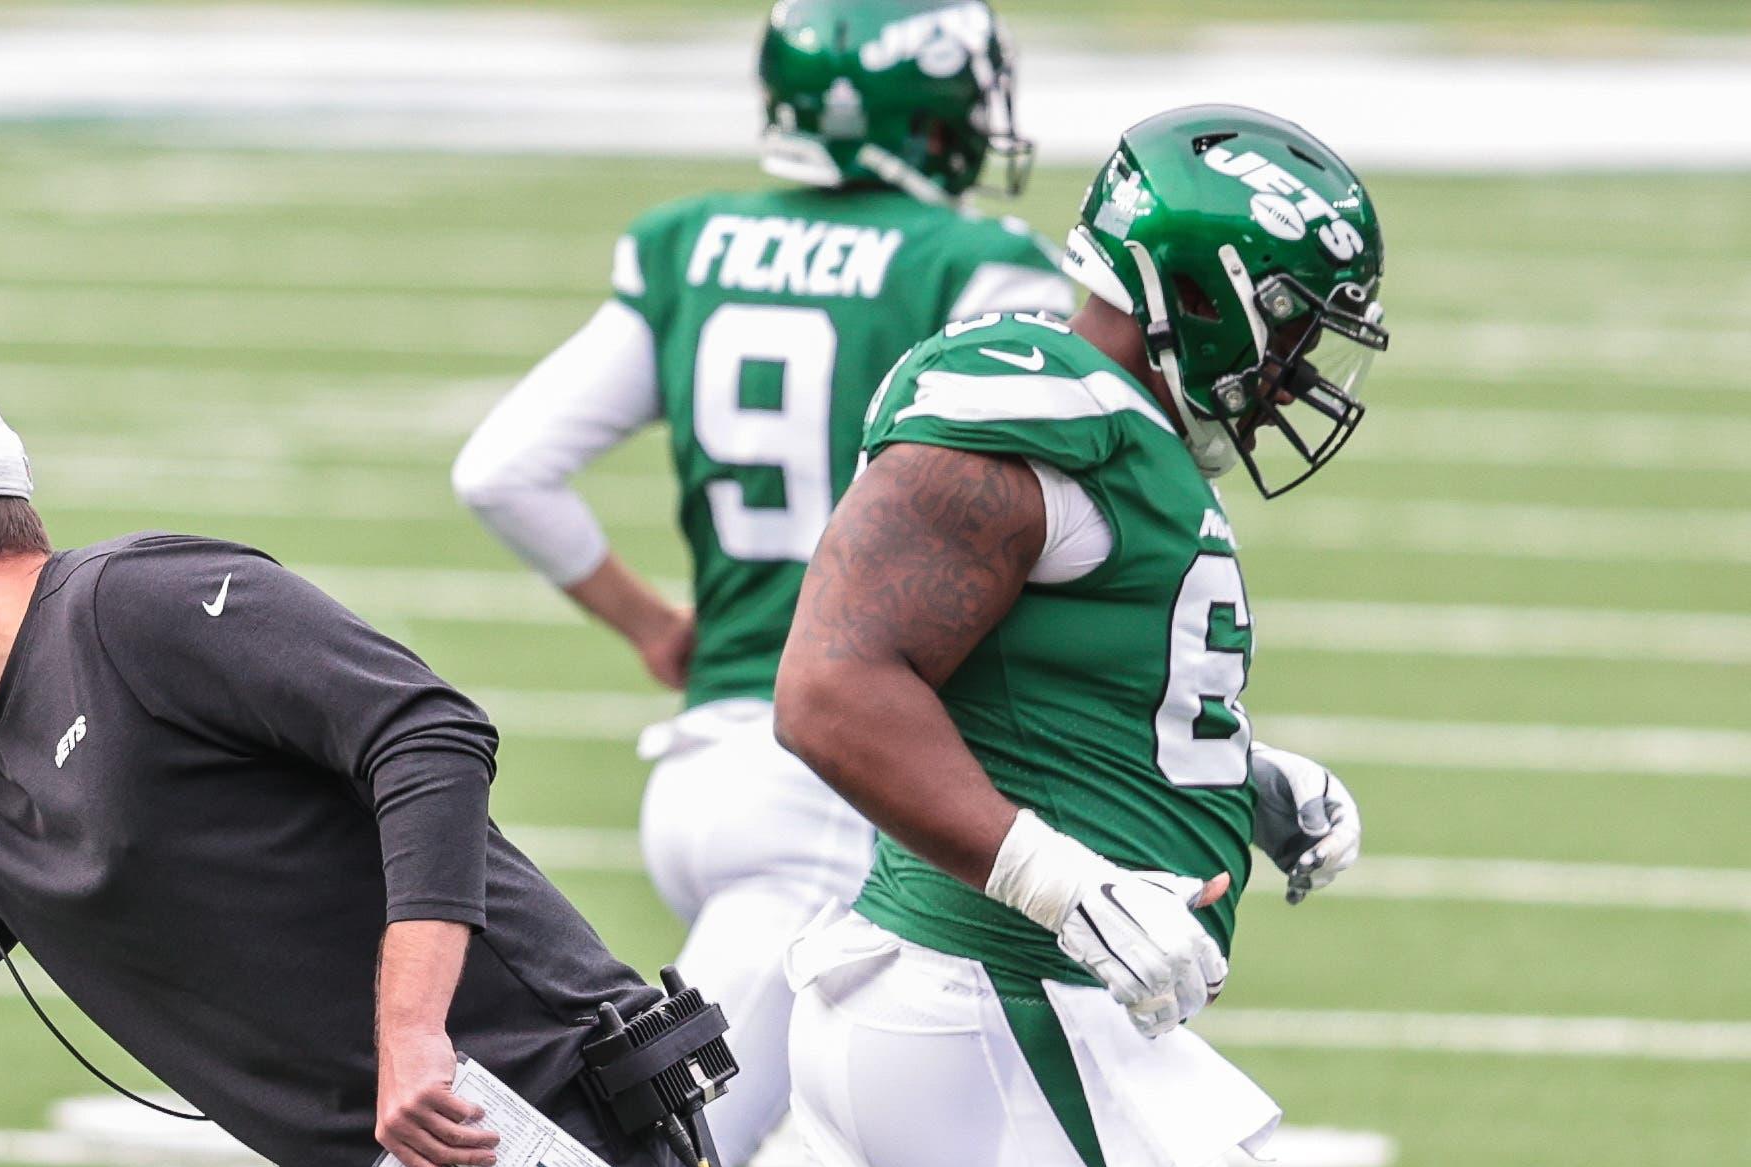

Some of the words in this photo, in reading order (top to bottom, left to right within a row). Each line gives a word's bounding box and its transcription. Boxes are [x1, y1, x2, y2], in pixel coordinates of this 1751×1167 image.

[1204, 147, 1364, 261] JETS
[686, 214, 902, 298] FICKEN
[693, 302, 838, 565] 9
[54, 714, 88, 769] JETS
